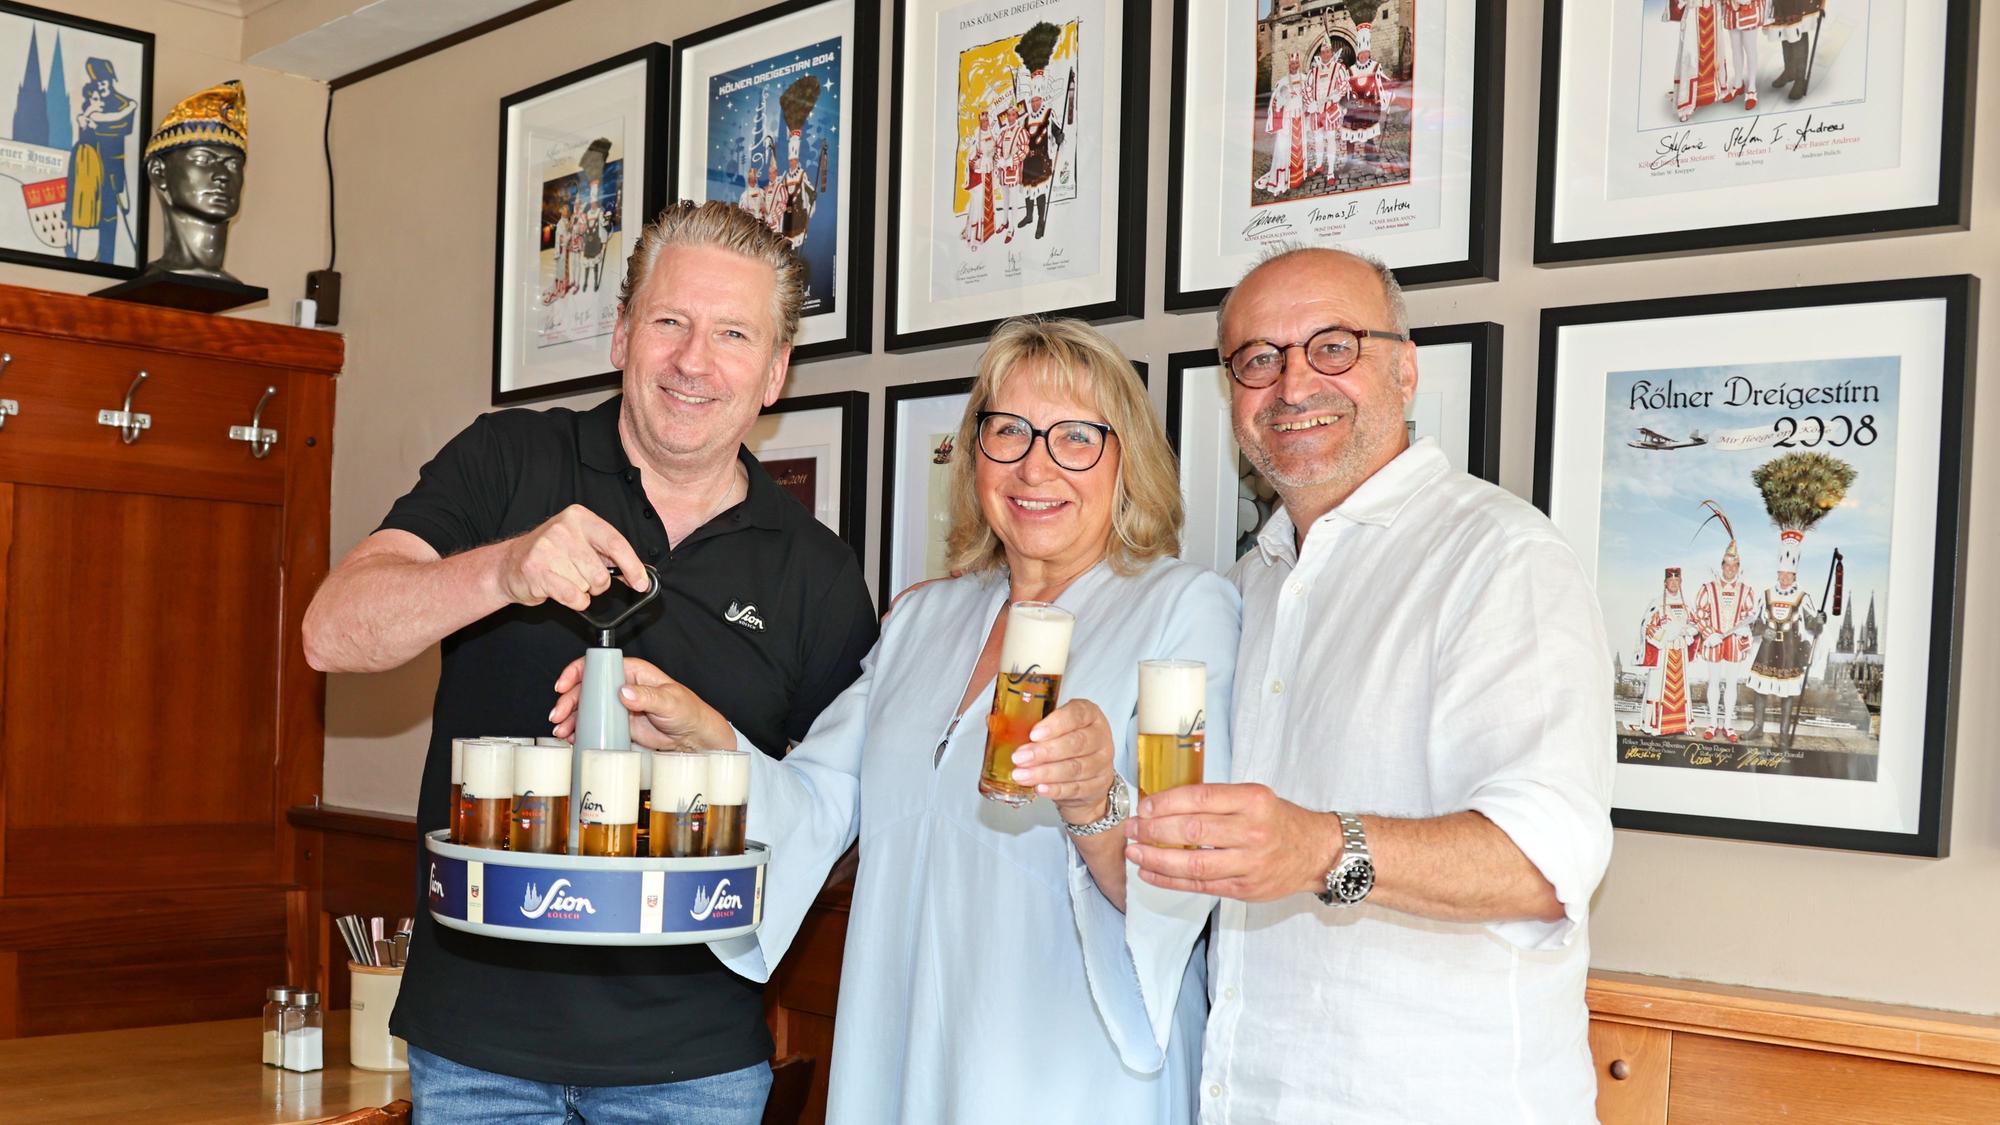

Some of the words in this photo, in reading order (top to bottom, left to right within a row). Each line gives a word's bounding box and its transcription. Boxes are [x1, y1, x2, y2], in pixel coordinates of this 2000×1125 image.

[959, 17, 976, 30] DAS
[977, 9, 1009, 25] KÖLNER
[1010, 0, 1061, 16] DREIGEST
[719, 78, 752, 96] KÖLNER
[754, 59, 811, 85] DREIGESTIRN
[812, 52, 835, 67] 2014
[1308, 207, 1346, 225] Thomas
[1630, 379, 1713, 410] Kölner
[1723, 376, 1879, 410] Dreigestirn
[1772, 414, 1878, 448] 2008
[724, 605, 764, 629] Sion
[1177, 709, 1206, 739] Sio
[520, 878, 596, 920] Sion
[690, 878, 743, 921] Sion
[712, 909, 735, 919] KÖLSCH
[547, 911, 580, 921] KÖLSCH
